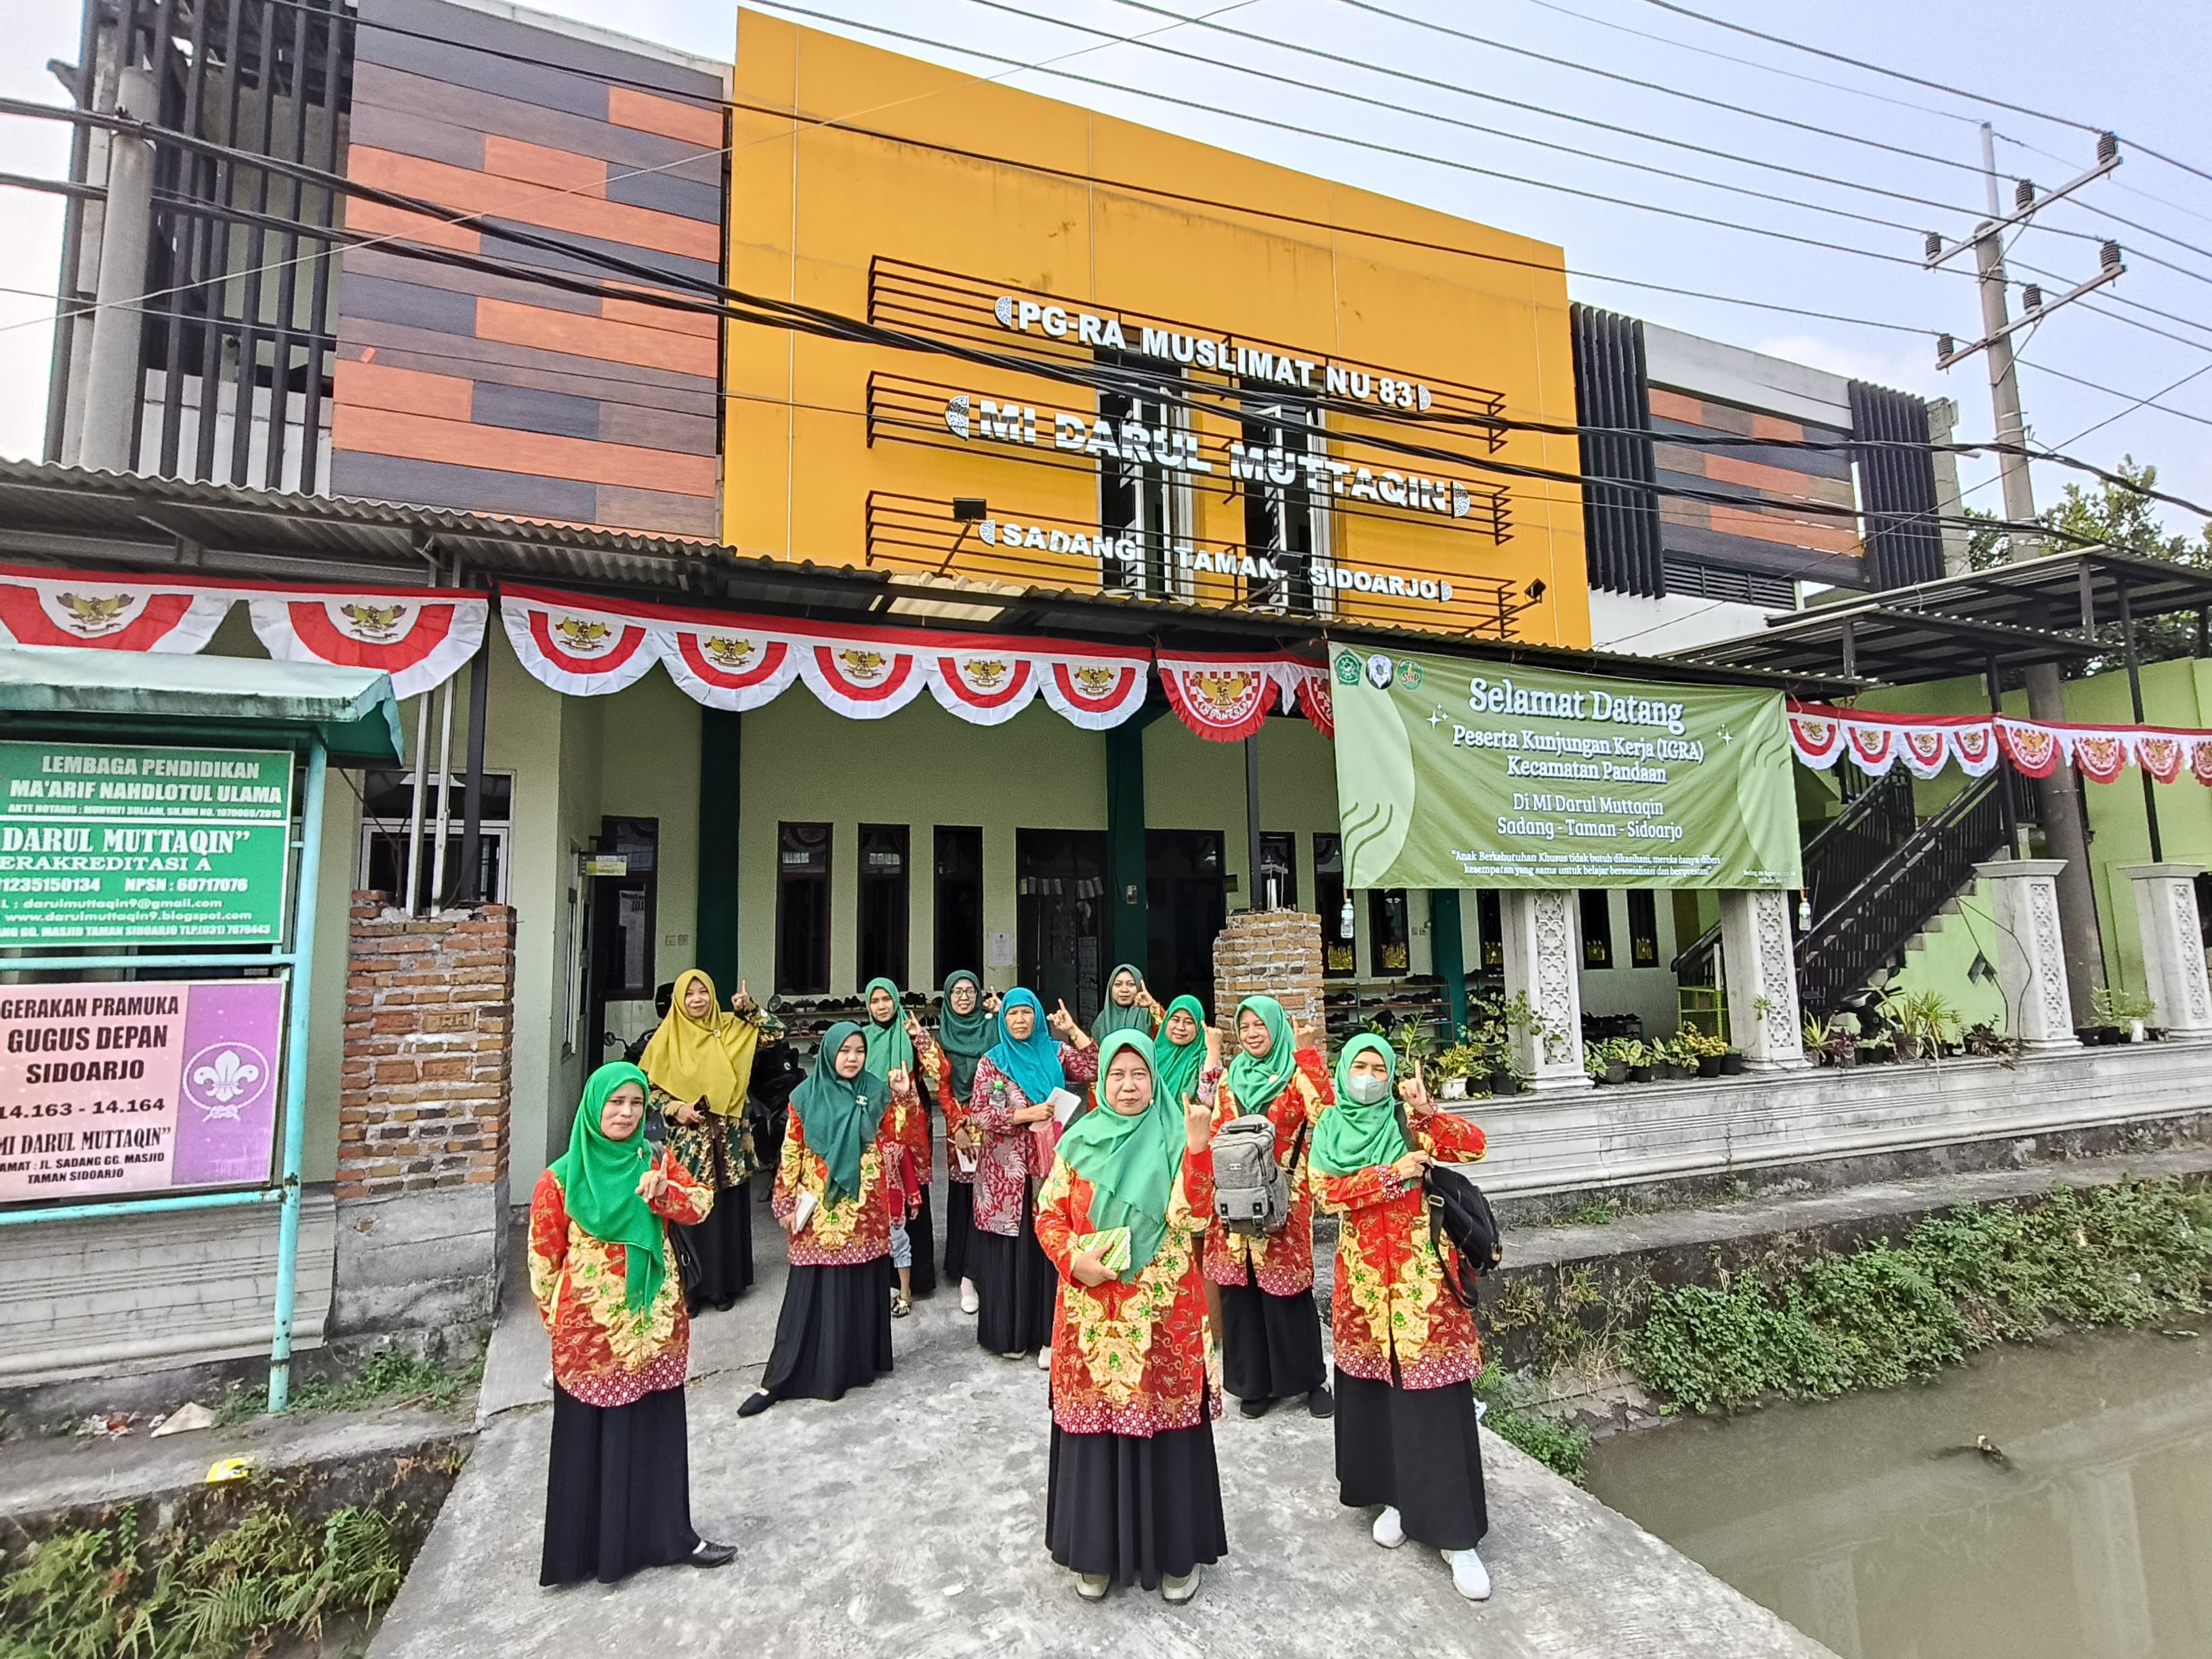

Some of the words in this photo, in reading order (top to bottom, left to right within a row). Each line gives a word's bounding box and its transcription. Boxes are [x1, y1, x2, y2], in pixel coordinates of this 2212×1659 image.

[1018, 300, 1126, 350] PG-RA
[1143, 327, 1314, 387] MUSLIMAT
[1326, 366, 1370, 398] NU
[1378, 377, 1412, 407] 83
[980, 400, 1035, 443] MI
[1054, 413, 1212, 473] DARUL
[1230, 444, 1446, 510] MUTTAQIN
[1002, 523, 1136, 561] SADANG
[1174, 547, 1277, 580] TAMAN
[1309, 567, 1436, 599] SIDOARJO
[1469, 678, 1585, 720] Selamat
[1589, 690, 1685, 735] Datang
[1452, 725, 1518, 749] Peserta
[1521, 730, 1612, 758] Kunjungan
[1613, 736, 1655, 761] Kerja
[1658, 738, 1704, 764] (IGRA)
[42, 756, 138, 775] LEMBAGA
[142, 759, 260, 779] PENDIDIKAN
[1507, 756, 1599, 779] Kecamatan
[1602, 761, 1666, 783] Pandaan
[9, 779, 96, 798] MA'ARIF
[100, 782, 213, 802] NAHDLOTUL
[217, 785, 281, 804] ULAMA
[35, 804, 78, 814] NOTARIS
[1513, 794, 1530, 811] Di
[1533, 794, 1552, 811] MI
[1555, 796, 1597, 813] Darul
[1600, 797, 1663, 819] Muttaqin
[1, 827, 94, 853] DARUL
[1498, 817, 1554, 840] Sadang
[1565, 819, 1617, 837] Taman
[1628, 821, 1683, 842] Sidoarjo
[194, 857, 212, 871] A
[1479, 851, 1536, 862] Berkebutuhan
[1538, 852, 1568, 863] Khusus
[1569, 853, 1589, 863] tidak
[1589, 853, 1612, 863] butuh
[1653, 855, 1677, 864] mereka
[1679, 855, 1700, 866] hanya
[1700, 855, 1721, 864] diberi
[1464, 863, 1514, 876] kesempatan
[1514, 865, 1534, 876] yang
[1535, 867, 1557, 875] sama
[1558, 865, 1582, 875] untuk
[1583, 865, 1609, 878] belajar
[1657, 867, 1669, 876] dan
[0, 878, 101, 892] 1235150134
[125, 878, 167, 892] NPSN
[177, 878, 248, 892] 60717076
[0, 899, 9, 909] L
[23, 898, 223, 910] darulmuttaqin9@gmail.com
[5, 911, 253, 923] www.darulmuttaqin9.blogspot.com
[41, 926, 84, 937] MASJID
[86, 926, 123, 937] TAMAN
[125, 925, 178, 936] SIDOARJO
[1, 998, 87, 1019] GERAKAN
[91, 996, 178, 1017] PRAMUKA
[7, 1027, 90, 1053] GUGUS
[96, 1025, 167, 1050] DEPAN
[26, 1059, 144, 1084] SIDOARJO
[0, 1103, 73, 1119] 14.163
[92, 1098, 165, 1114] 14.164
[21, 1132, 75, 1154] DARUL
[56, 1157, 101, 1169] SADANG
[125, 1152, 165, 1164] MASJID
[28, 1172, 66, 1184] TAMAN
[69, 1168, 123, 1181] SIDOARJO
